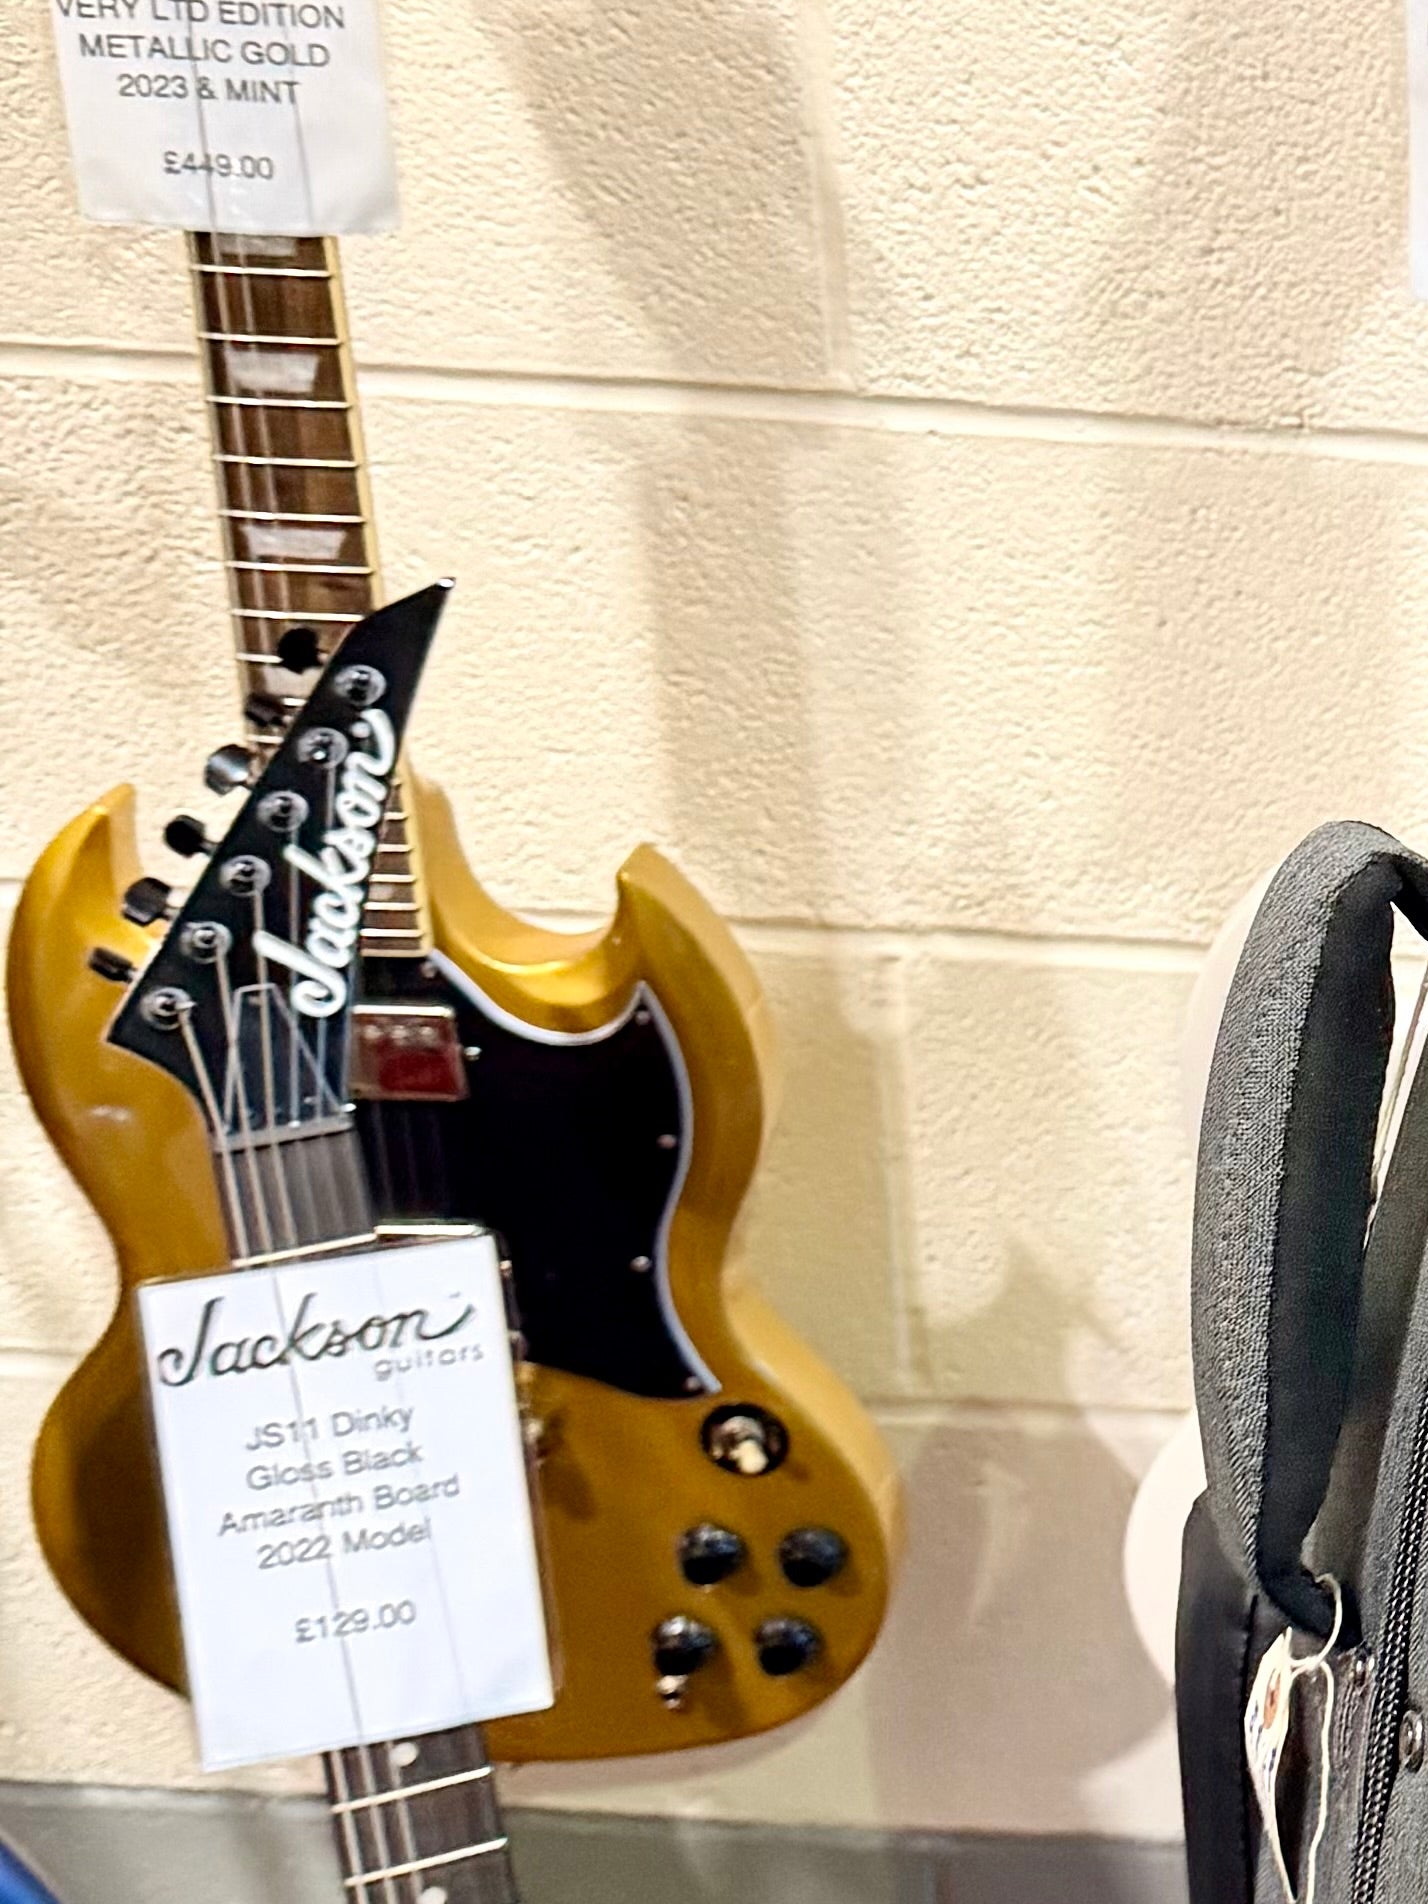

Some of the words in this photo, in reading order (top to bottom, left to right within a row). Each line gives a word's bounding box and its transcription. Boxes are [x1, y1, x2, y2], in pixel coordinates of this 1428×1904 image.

[220, 1, 345, 30] EDITION
[79, 34, 232, 63] METALLIC
[240, 39, 330, 67] GOLD
[118, 73, 188, 99] 2023
[196, 76, 216, 101] &
[226, 79, 300, 105] MINT
[164, 151, 274, 181] £449.00
[253, 707, 396, 1019] Jackson
[158, 1292, 475, 1387] Jackson
[374, 1344, 485, 1382] guitars
[246, 1419, 319, 1452] JS11
[333, 1402, 415, 1441] Dinky
[246, 1457, 333, 1491] Gloss
[344, 1441, 422, 1475] Black
[218, 1493, 365, 1537] Amaranth
[374, 1473, 460, 1508] Board
[257, 1536, 332, 1570] 2022
[342, 1517, 432, 1555] Model
[294, 1600, 417, 1644] £129.00
